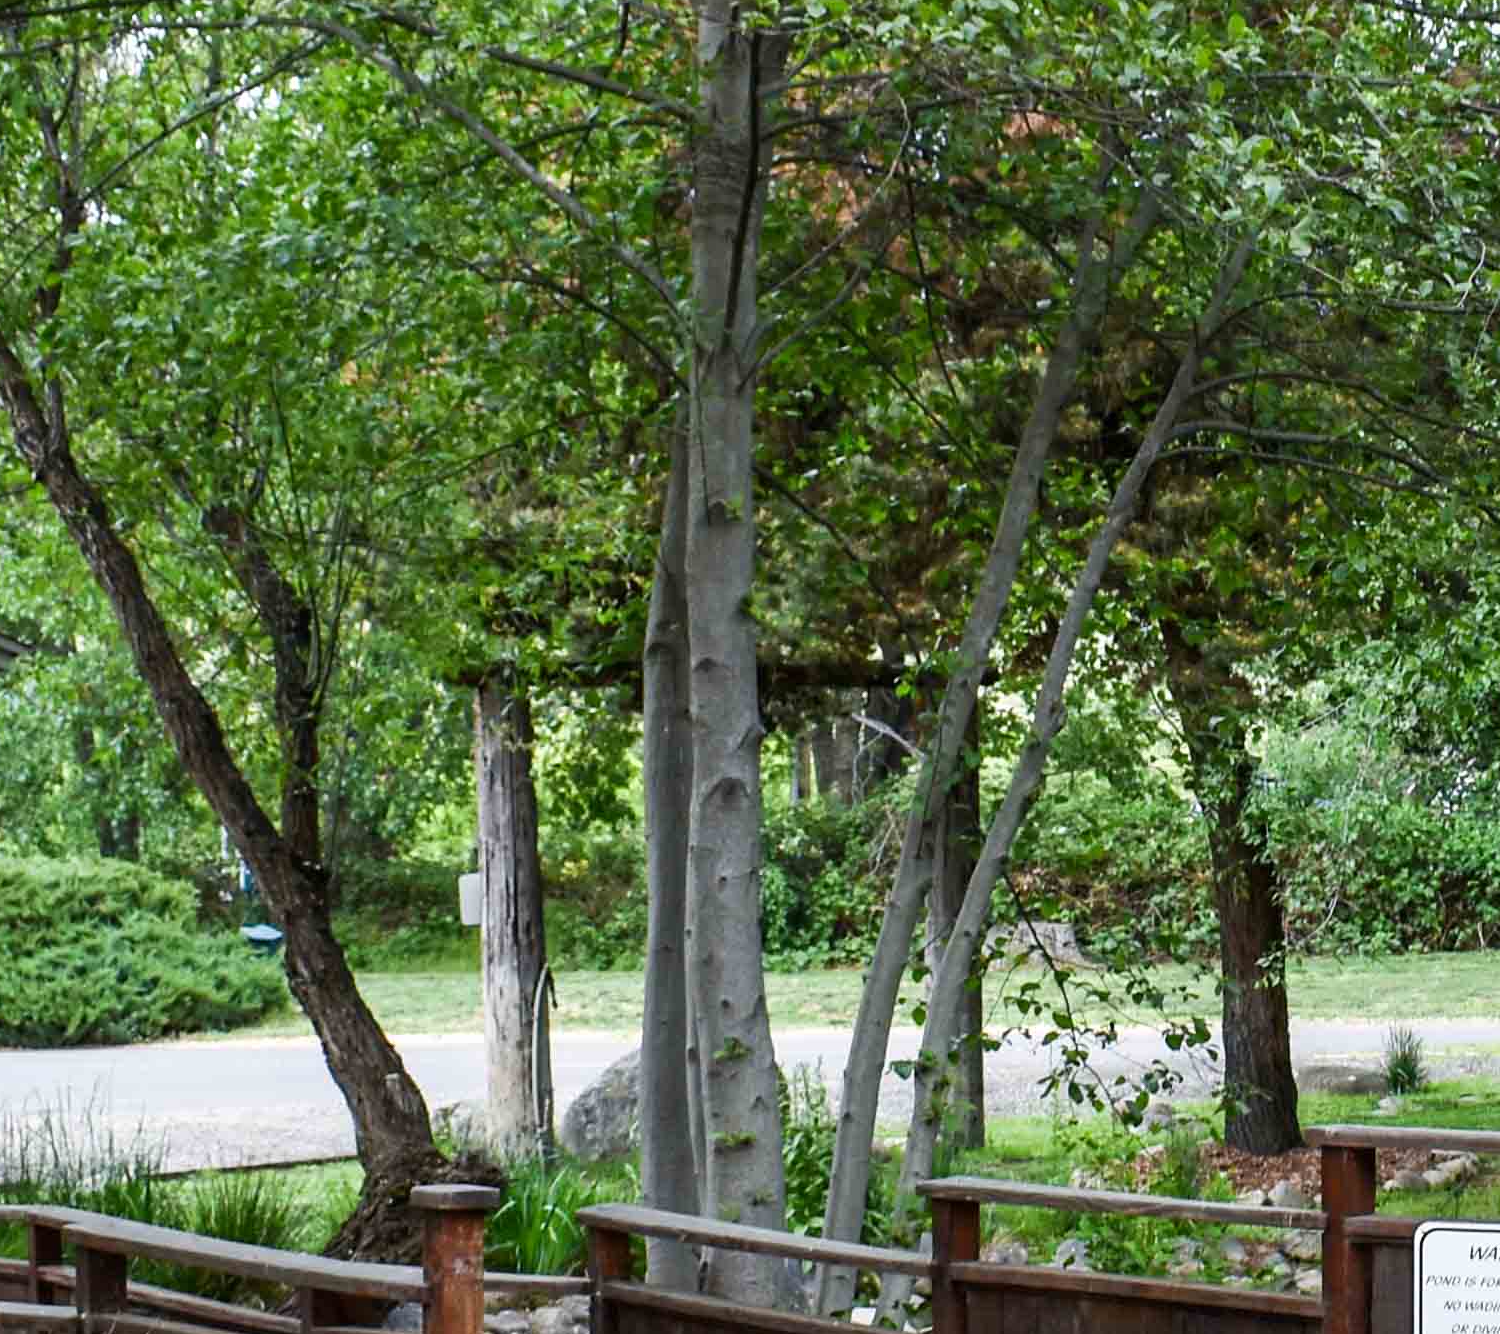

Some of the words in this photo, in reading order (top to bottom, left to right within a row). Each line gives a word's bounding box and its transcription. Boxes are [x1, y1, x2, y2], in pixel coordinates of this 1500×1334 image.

[1426, 1275, 1461, 1287] POND
[1464, 1276, 1477, 1287] IS
[1443, 1300, 1462, 1312] NO
[1451, 1323, 1470, 1334] OR
